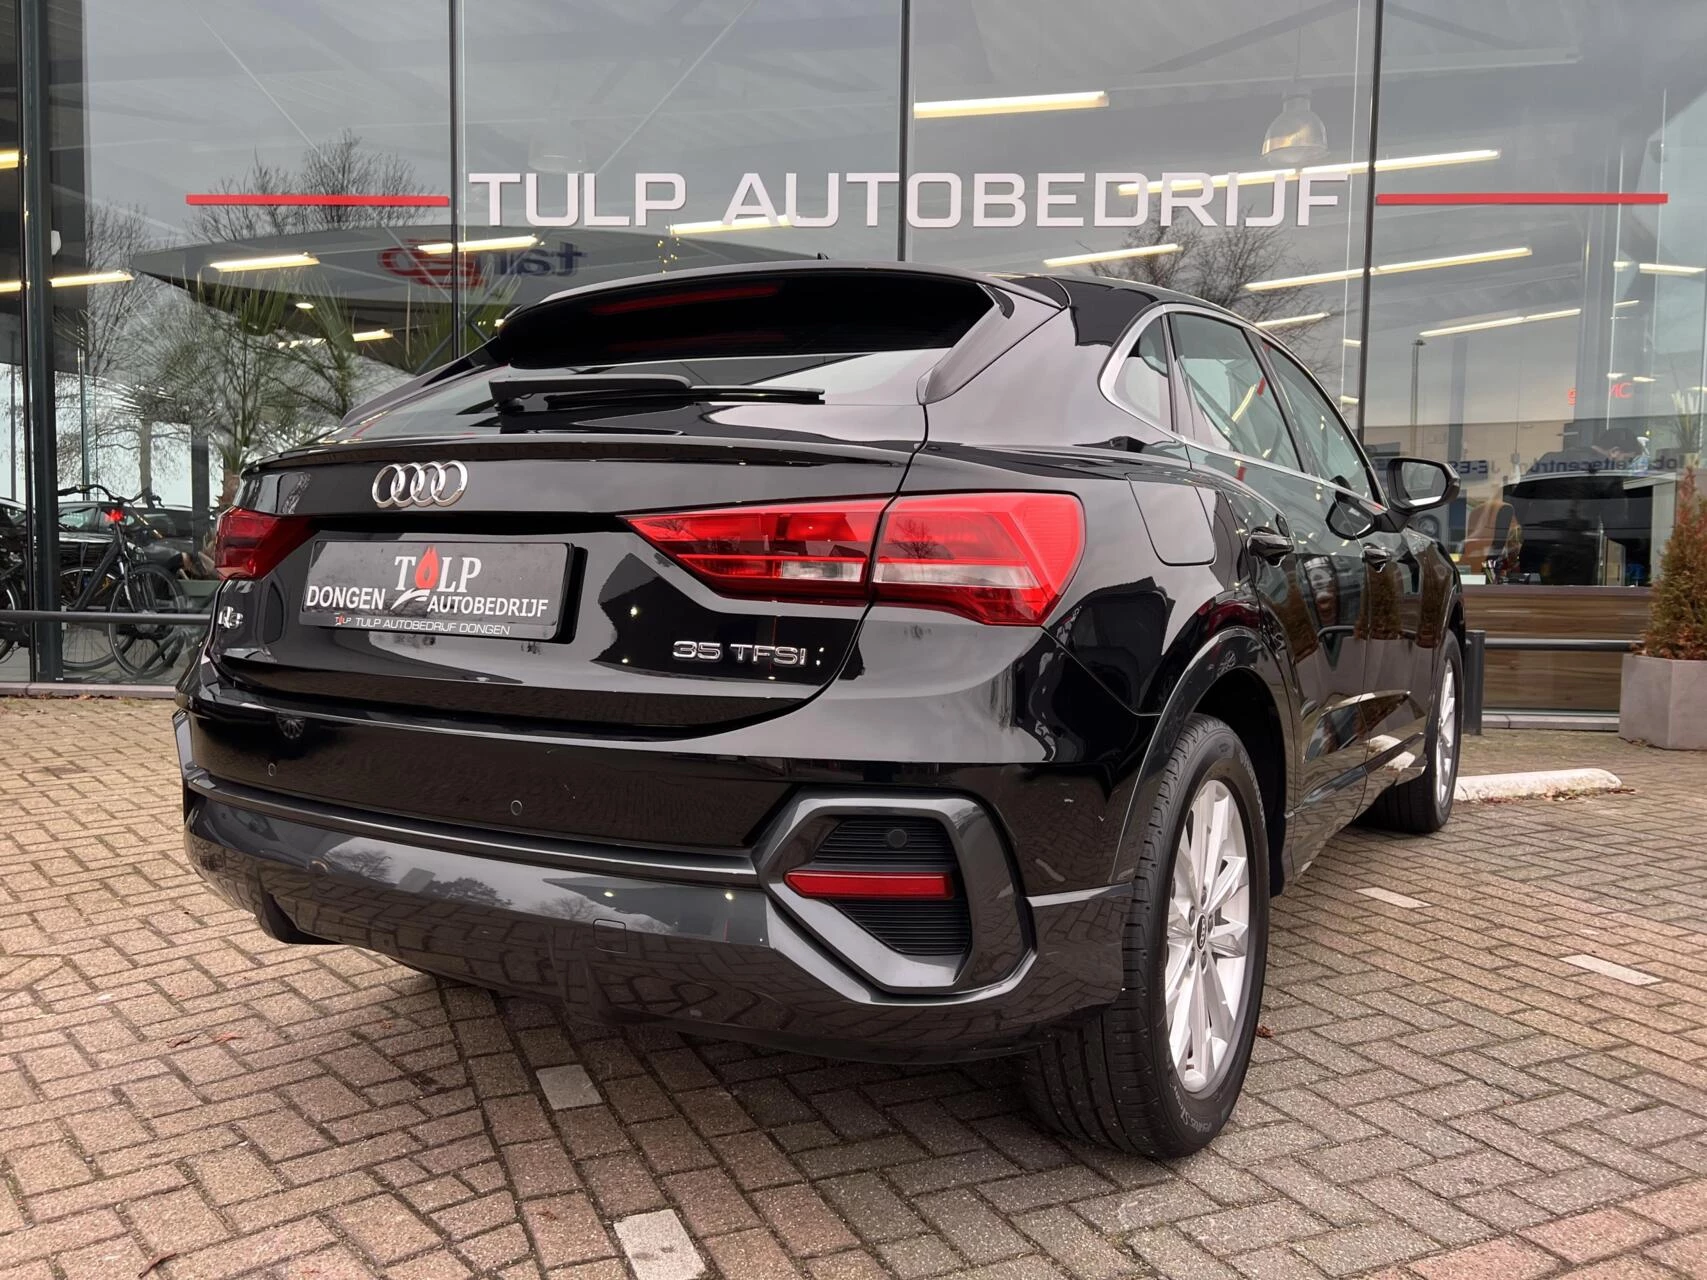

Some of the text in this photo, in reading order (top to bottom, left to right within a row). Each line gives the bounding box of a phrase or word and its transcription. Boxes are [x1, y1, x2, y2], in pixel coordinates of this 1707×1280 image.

[468, 172, 1349, 229] TULP AUTOBEDRIJF
[306, 585, 386, 610] DONGEN
[426, 595, 549, 618] AUTOBEDRIJF
[355, 617, 382, 628] TULP
[383, 619, 458, 632] AUTOBEDRIJF
[459, 623, 511, 636] DONGEN
[673, 641, 806, 666] 35 TFSI
